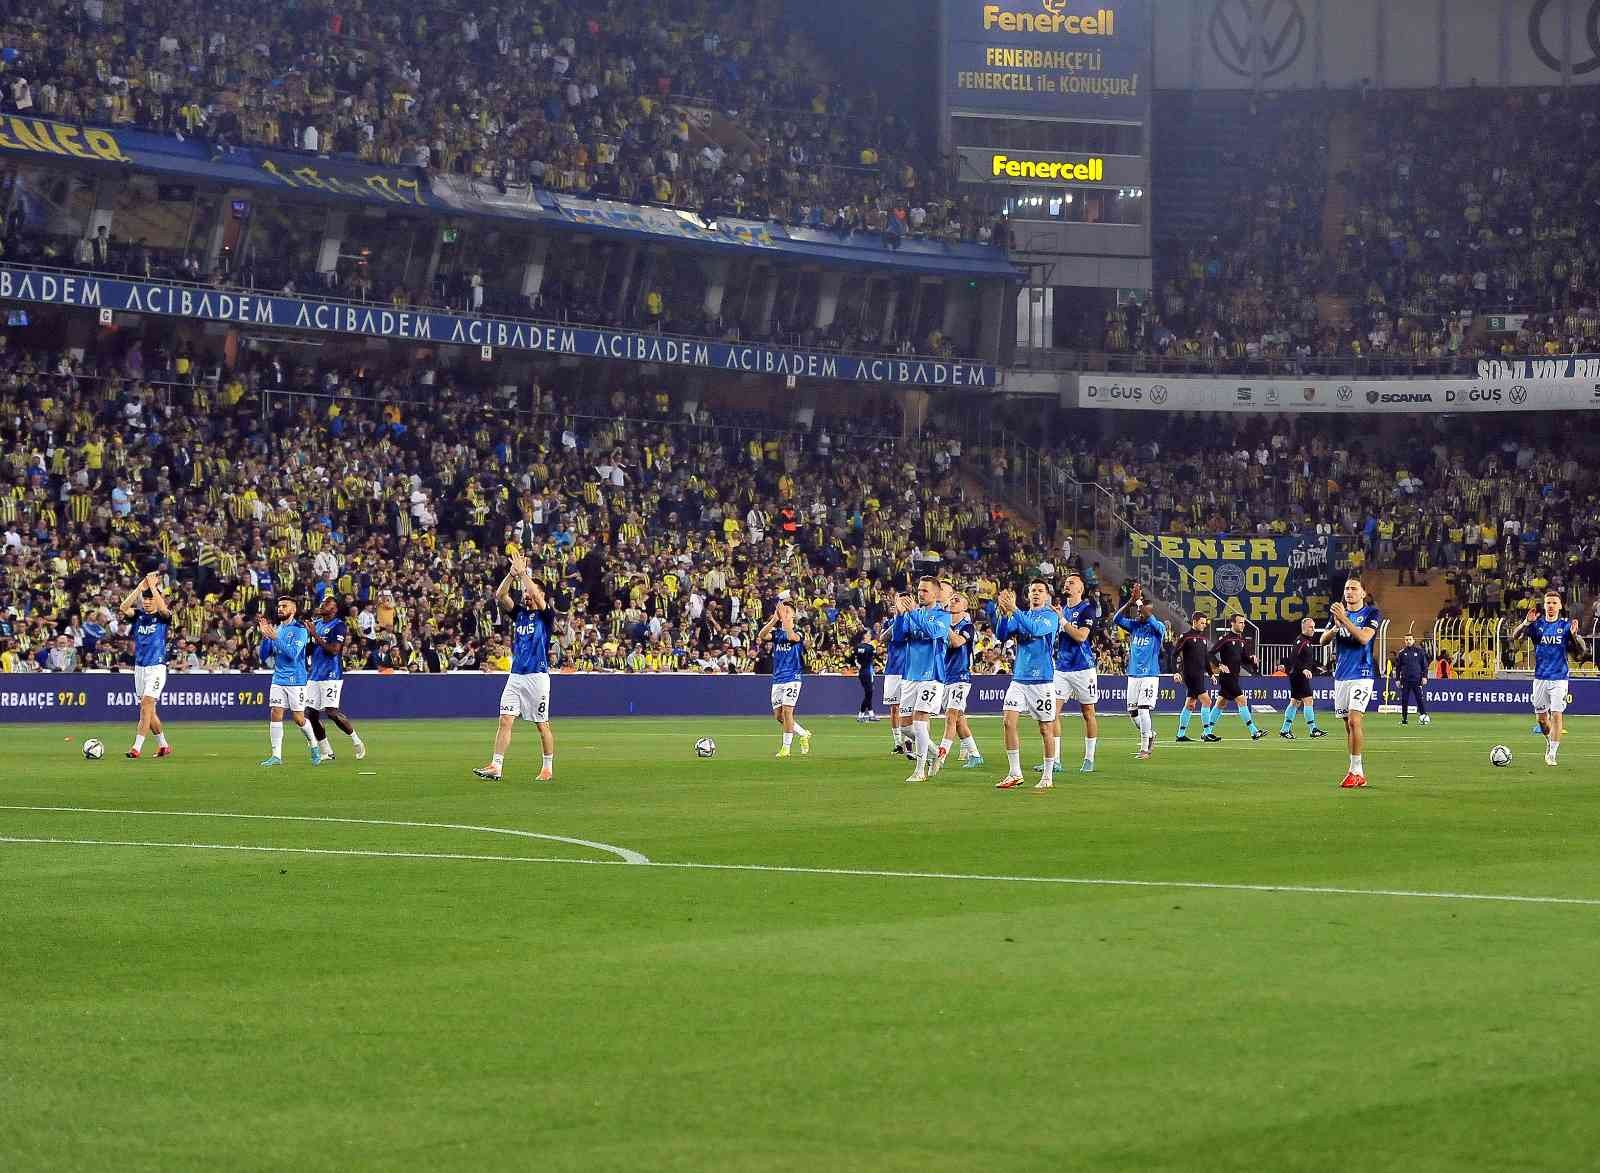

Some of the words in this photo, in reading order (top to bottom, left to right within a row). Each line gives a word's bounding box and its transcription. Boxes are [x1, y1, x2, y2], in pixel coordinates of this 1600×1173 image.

[983, 5, 1114, 35] Fenercell
[957, 71, 1034, 92] FENERCELL
[1037, 74, 1056, 92] ile
[992, 154, 1103, 181] Fenercell
[126, 285, 273, 324] ACIBADEM
[295, 302, 431, 340] ACIBADEM
[450, 318, 576, 353] ACIBADEM
[594, 333, 709, 366] ACIBADEM
[726, 348, 838, 378] ACIBADEM
[855, 359, 985, 386] ACIBADEM
[1380, 393, 1433, 402] SCANIA
[1129, 532, 1278, 561] FENER
[1540, 635, 1562, 645] AVIS
[786, 687, 798, 698] 25
[951, 690, 963, 700] 14
[1087, 684, 1096, 695] 11
[1353, 689, 1369, 702] 27
[1382, 691, 1400, 701] 97.
[58, 692, 87, 706] 97.0
[106, 692, 141, 706] RADY
[159, 692, 235, 709] ENERBAHÇE
[238, 692, 264, 706] 97.0
[921, 690, 936, 703] 37
[1425, 691, 1464, 702] RADYO
[1467, 692, 1535, 704] FENERBAH
[538, 701, 547, 713] 8
[1036, 699, 1052, 711] 26
